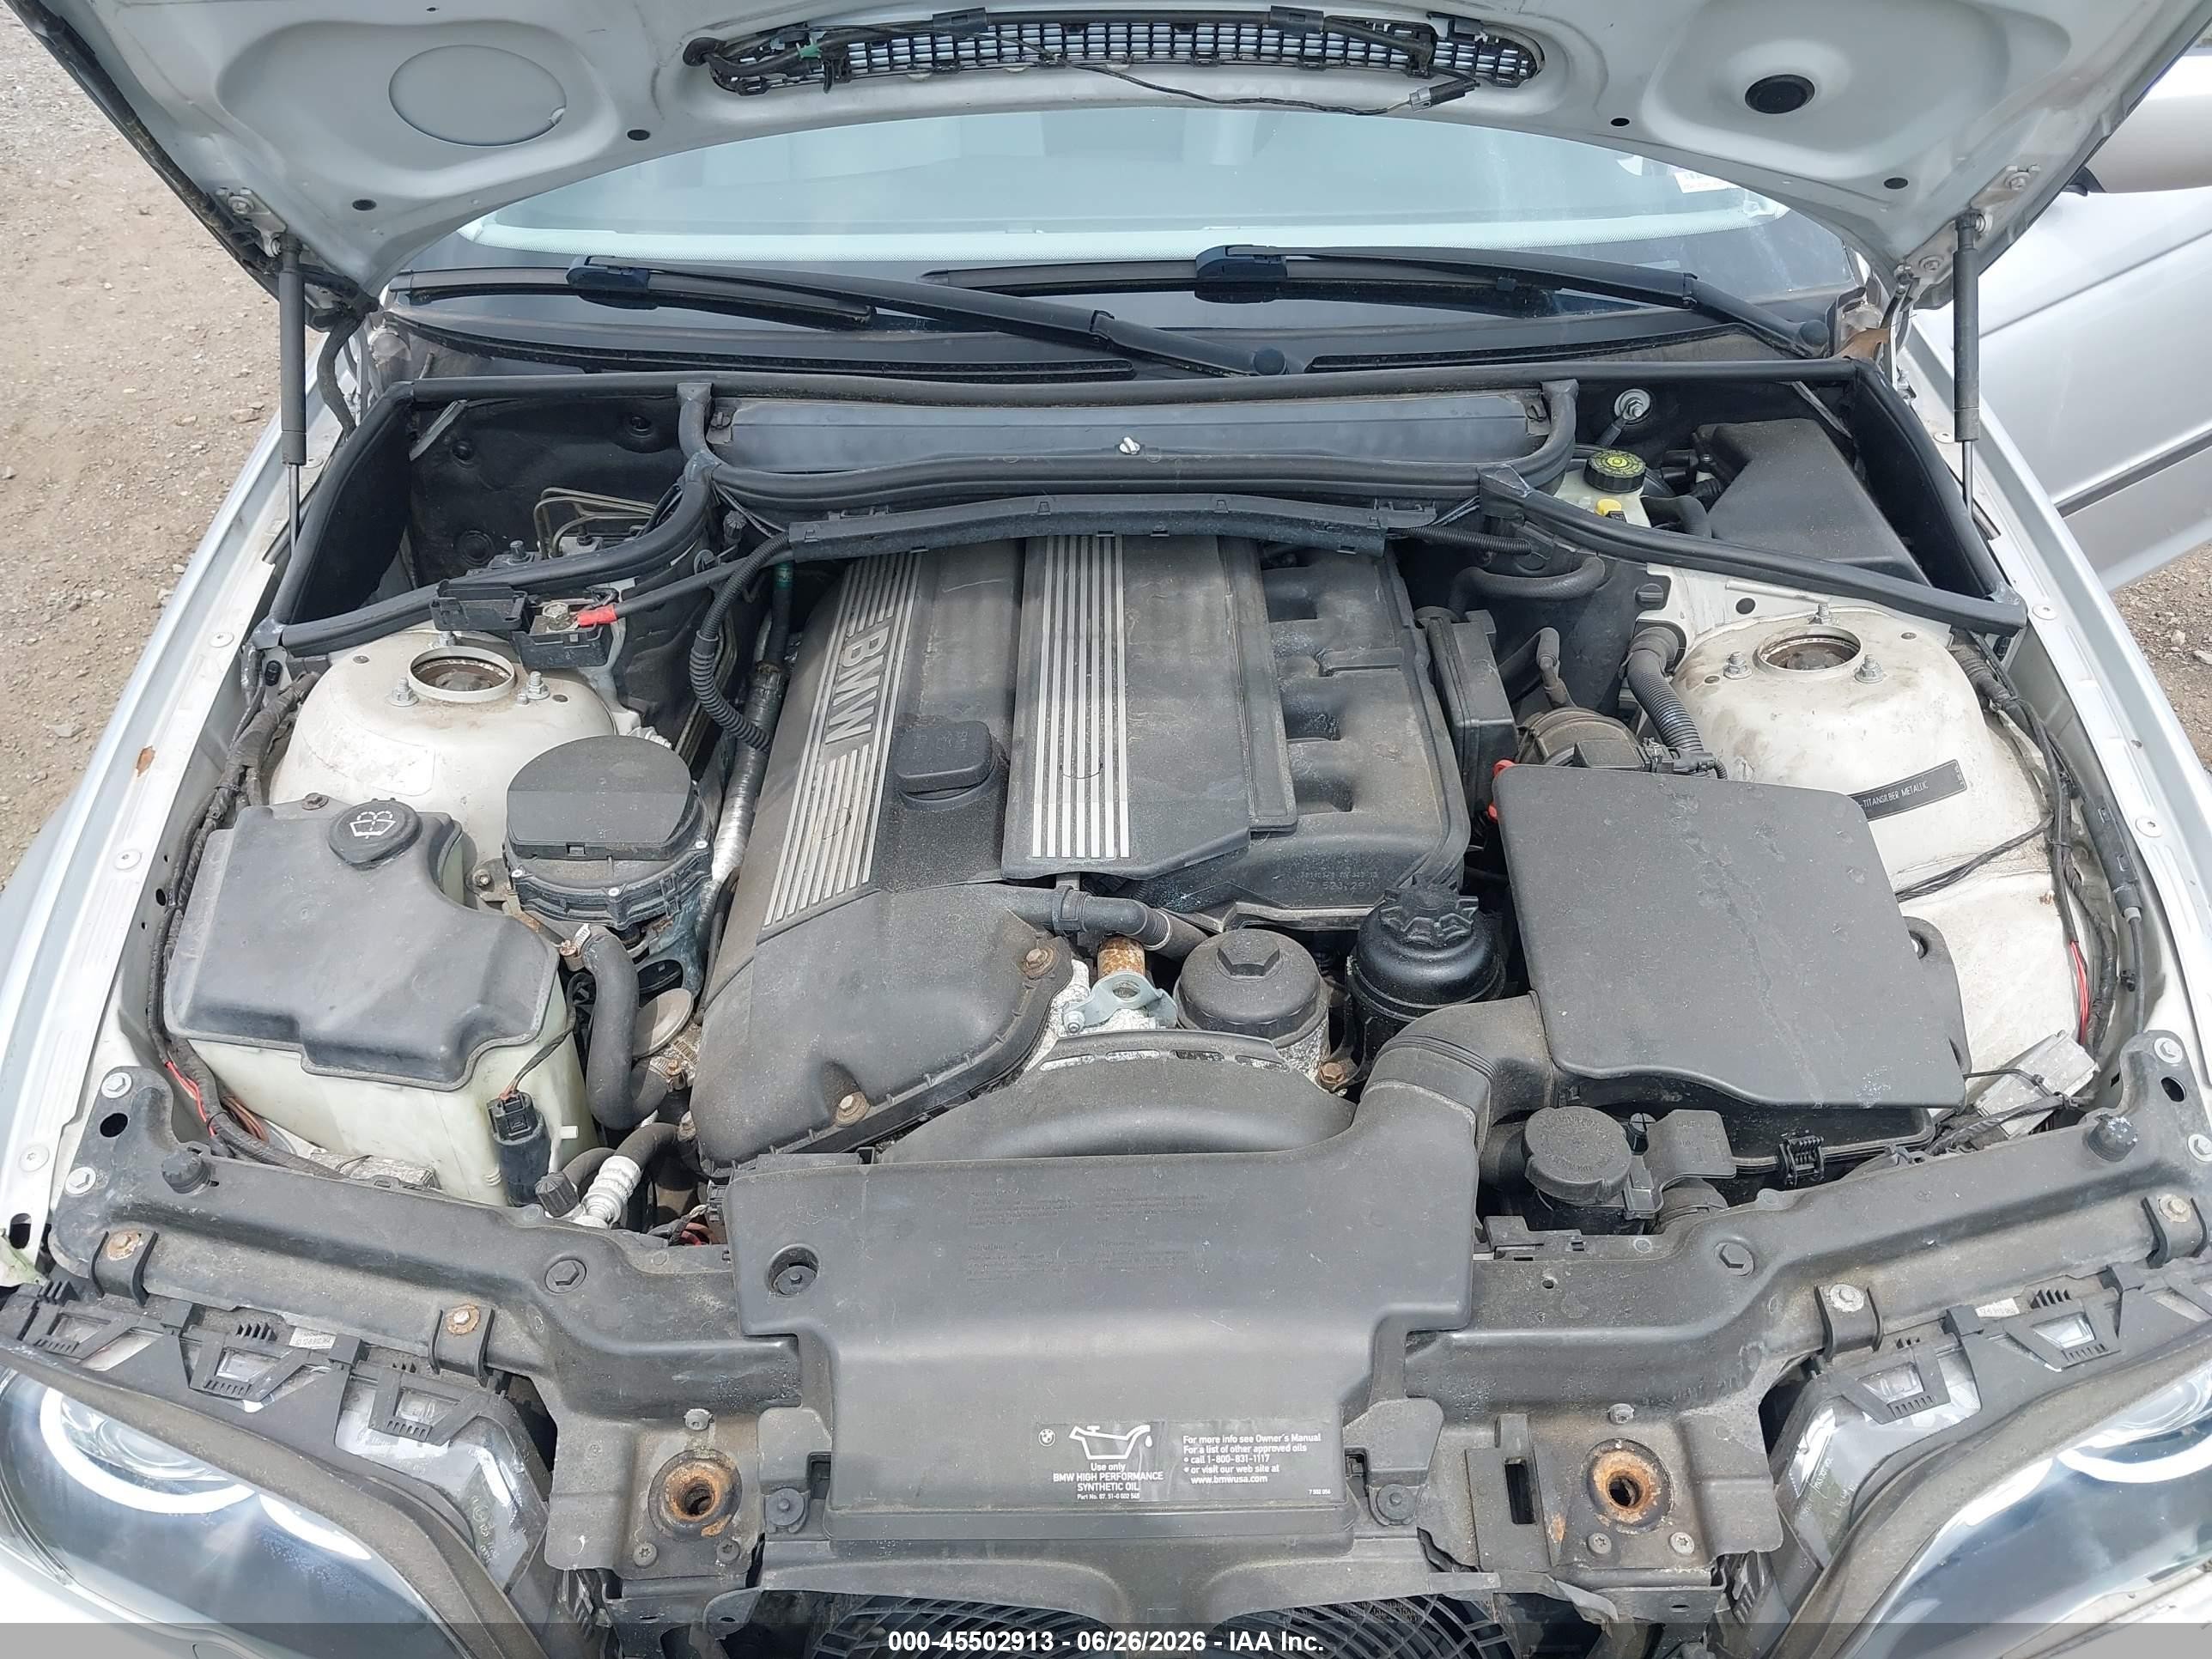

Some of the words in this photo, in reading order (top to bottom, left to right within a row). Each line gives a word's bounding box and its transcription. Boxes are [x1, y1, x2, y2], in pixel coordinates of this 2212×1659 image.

[824, 626, 890, 744] BMW
[1183, 1435, 1197, 1443] For
[1291, 1433, 1321, 1442] Manual
[1183, 1445, 1198, 1454] For
[1206, 1444, 1218, 1453] list
[1220, 1444, 1228, 1453] of
[1230, 1444, 1252, 1453] other
[1254, 1443, 1291, 1455] approved
[1292, 1443, 1307, 1452] oils
[1207, 1454, 1269, 1463] 1-800-831-1117
[1108, 1462, 1126, 1473] only
[1201, 1464, 1218, 1474] visit
[1236, 1464, 1253, 1473] web
[1255, 1464, 1269, 1473] site
[1271, 1464, 1279, 1473] at
[1053, 1473, 1074, 1481] BMW
[1077, 1473, 1097, 1481] HIGH
[1099, 1471, 1164, 1480] PERFORMANCE
[1191, 1475, 1267, 1484] www.bmwusa.com
[1077, 1482, 1123, 1492] SYNTHETIC
[1126, 1482, 1139, 1491] OIL
